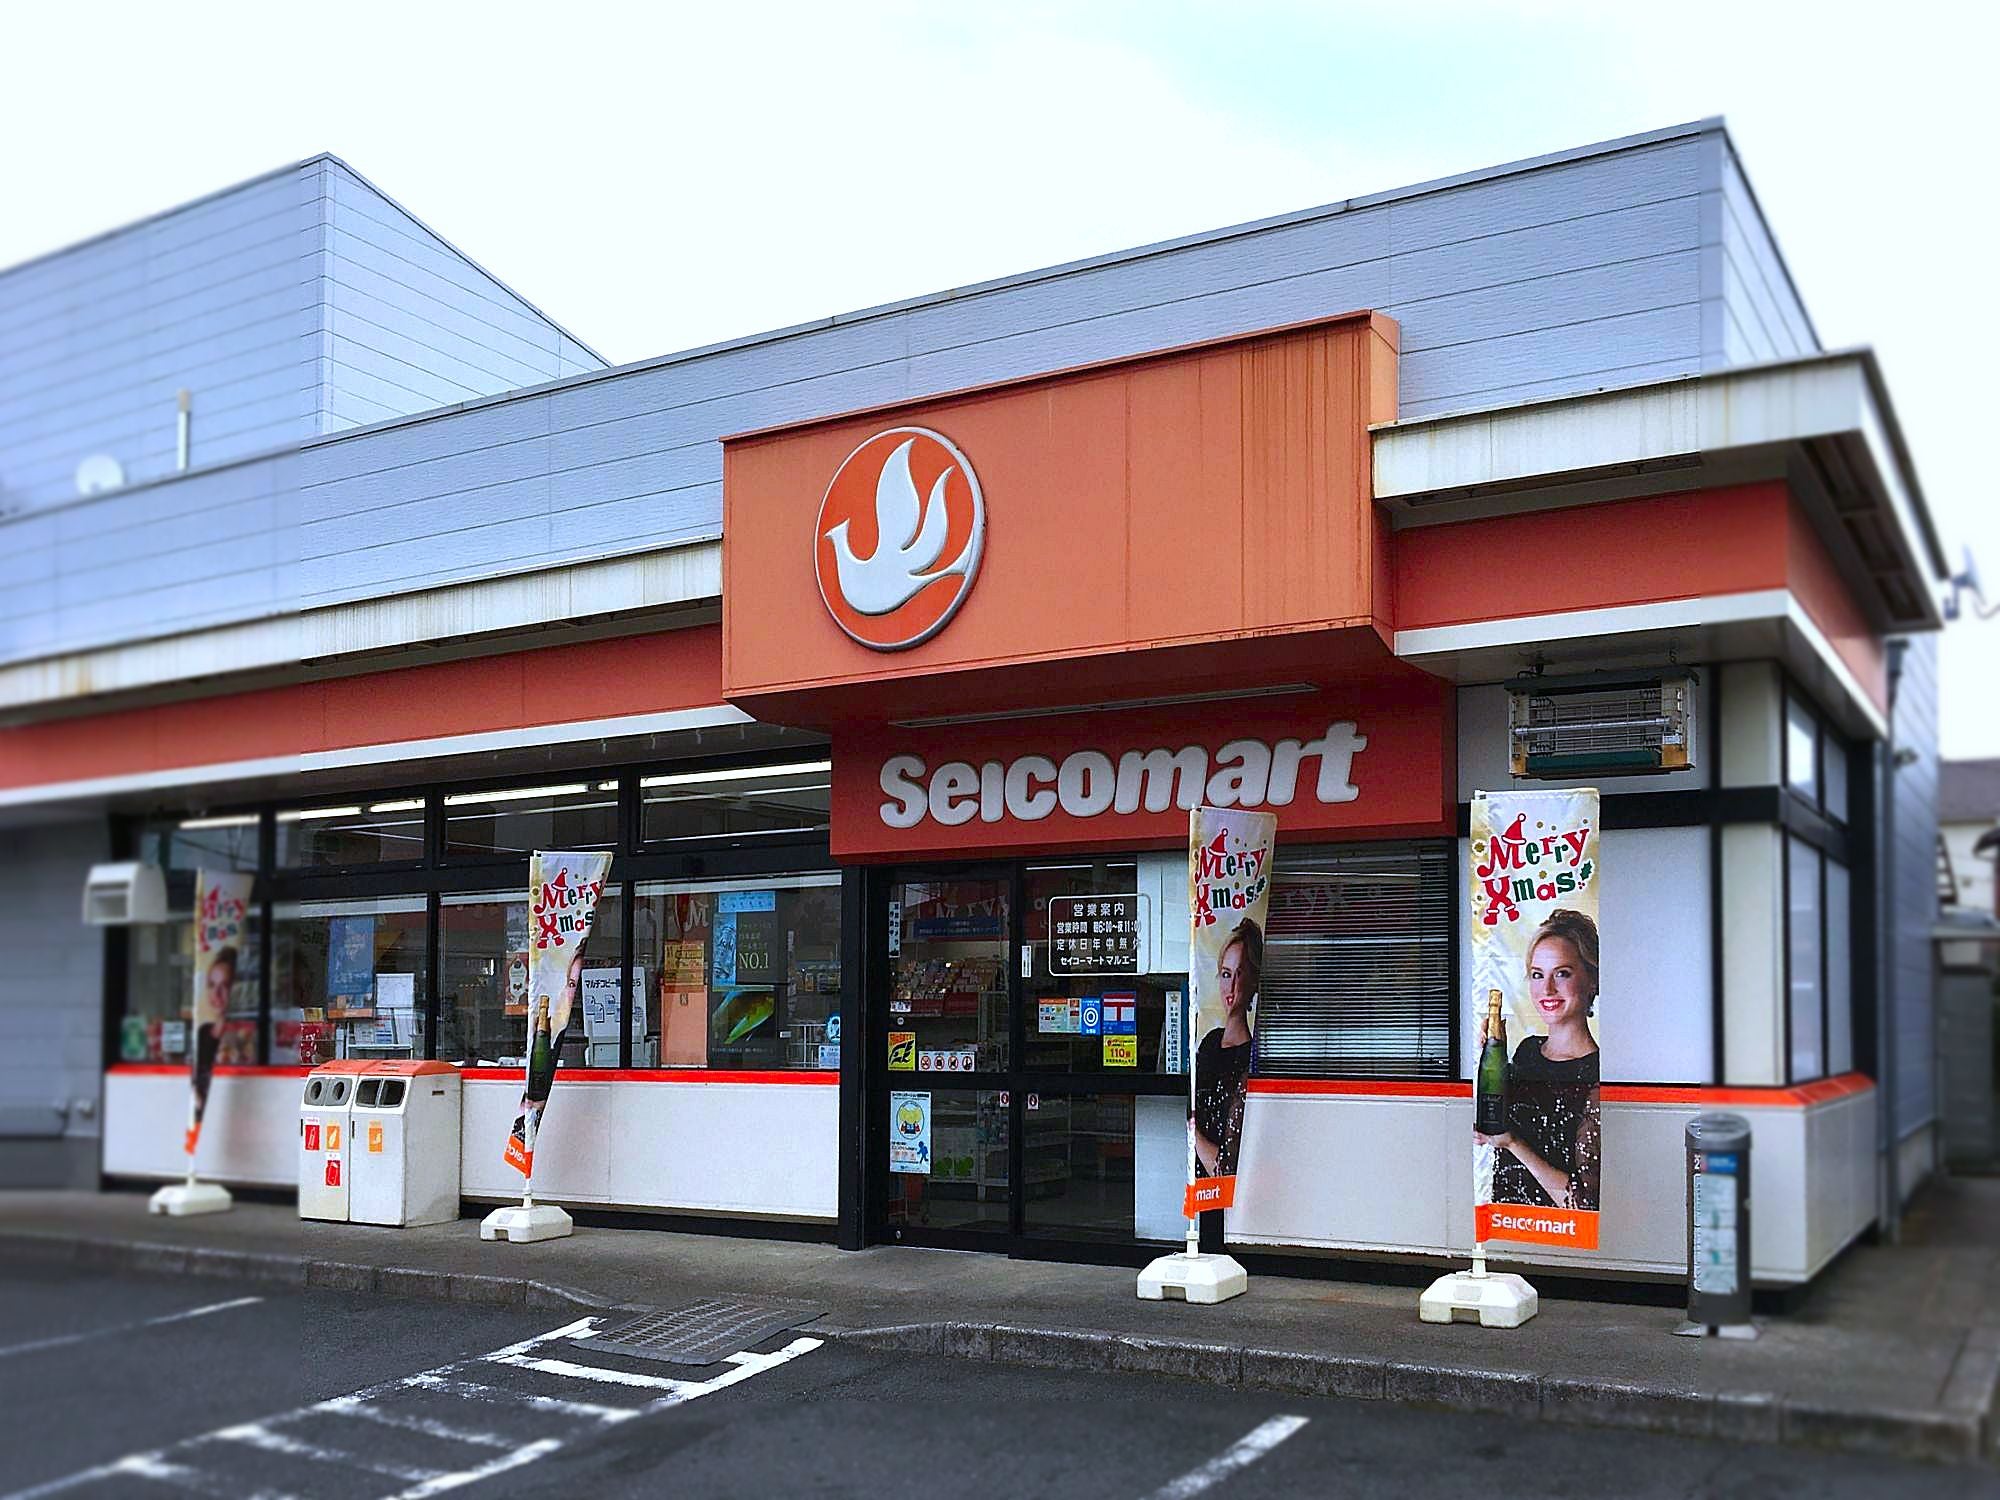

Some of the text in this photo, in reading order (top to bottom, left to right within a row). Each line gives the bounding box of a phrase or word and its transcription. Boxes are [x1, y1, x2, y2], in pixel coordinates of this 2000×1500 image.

[880, 720, 1367, 828] Seicomart
[1195, 846, 1267, 884] Merry
[1477, 828, 1590, 877] Merry
[533, 881, 601, 914] Merry
[1073, 902, 1125, 917] 営業案内
[1195, 883, 1256, 928] Xmas
[1482, 872, 1576, 925] Xmas
[536, 909, 595, 949] Xmas
[1056, 920, 1088, 934] 営業時間
[737, 952, 770, 970] NO.1
[1060, 955, 1137, 966] セイコーマートマルエー
[1491, 1213, 1577, 1236] Seicomart
